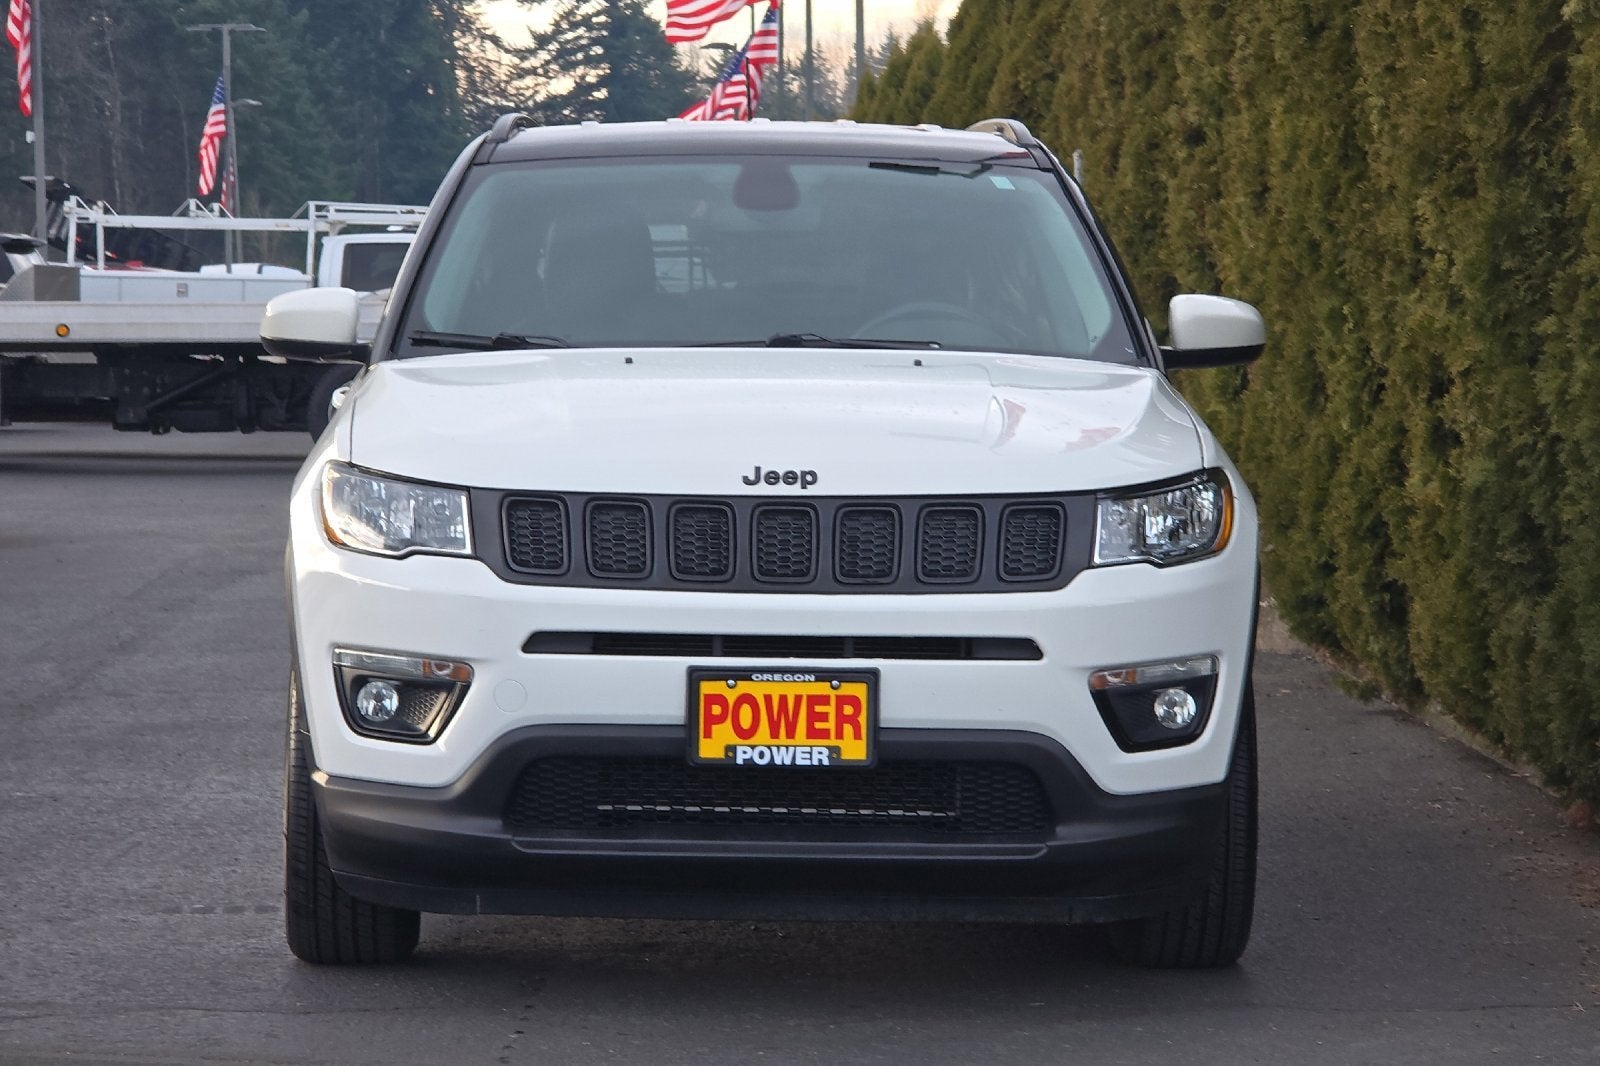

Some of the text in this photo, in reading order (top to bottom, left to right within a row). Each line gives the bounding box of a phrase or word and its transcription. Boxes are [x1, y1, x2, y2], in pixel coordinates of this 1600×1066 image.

[742, 466, 818, 489] Jeep
[751, 673, 816, 682] OREGON
[703, 692, 863, 740] POWER
[735, 745, 830, 766] POWER
